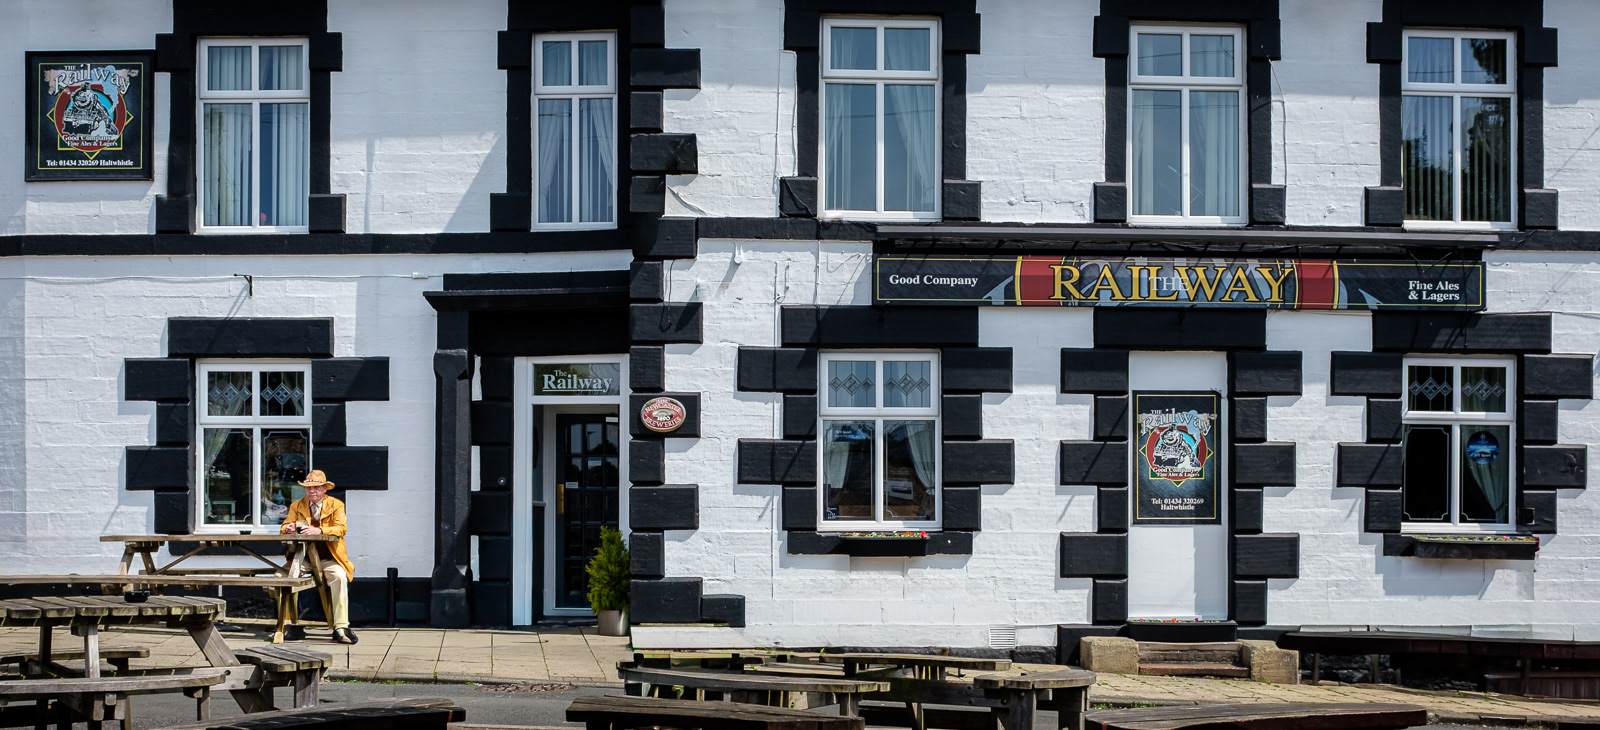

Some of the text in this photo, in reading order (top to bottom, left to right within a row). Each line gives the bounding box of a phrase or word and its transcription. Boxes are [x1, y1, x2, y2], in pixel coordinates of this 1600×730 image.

[54, 63, 130, 95] Railway
[889, 274, 978, 287] Good Company
[1049, 265, 1294, 302] RAILWAY
[1148, 276, 1190, 291] THE
[1408, 280, 1460, 290] Fine Ales
[1408, 290, 1460, 302] & Lagers
[542, 374, 612, 392] Railway
[644, 402, 682, 413] NEWCASTLE
[644, 416, 681, 428] BREWERIES
[1141, 408, 1212, 436] Railway
